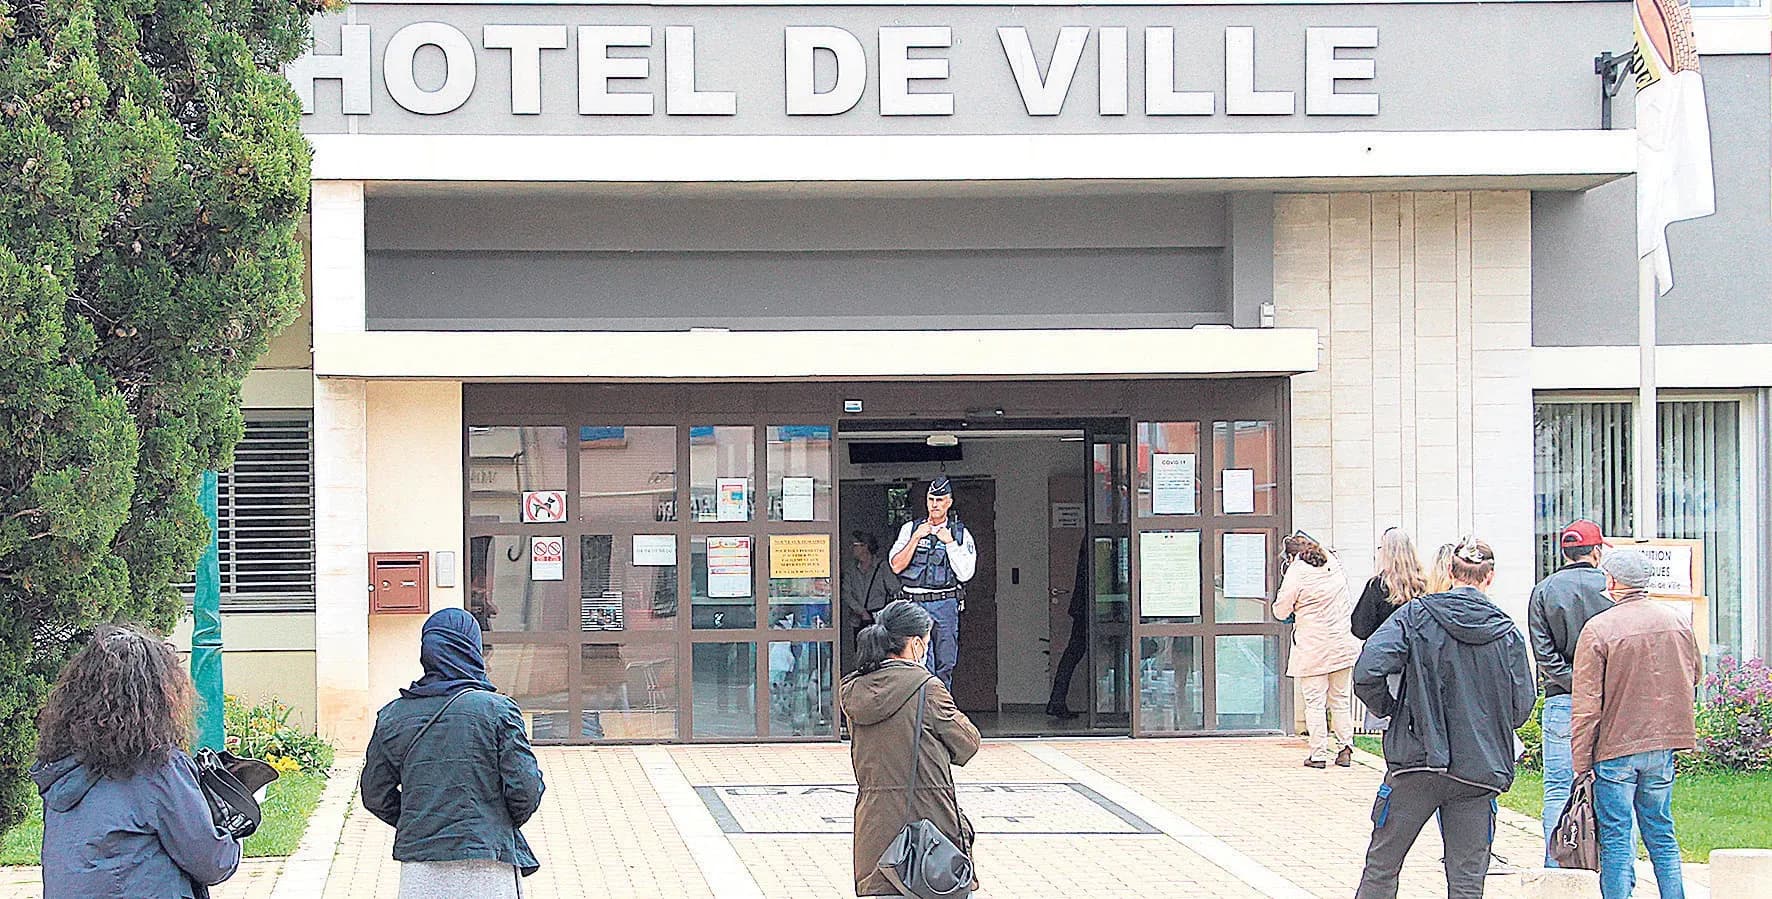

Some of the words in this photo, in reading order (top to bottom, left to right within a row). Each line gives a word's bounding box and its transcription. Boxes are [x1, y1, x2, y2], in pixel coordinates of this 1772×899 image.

[284, 21, 737, 116] HOTEL
[785, 26, 954, 116] DE
[997, 26, 1381, 116] VILLE
